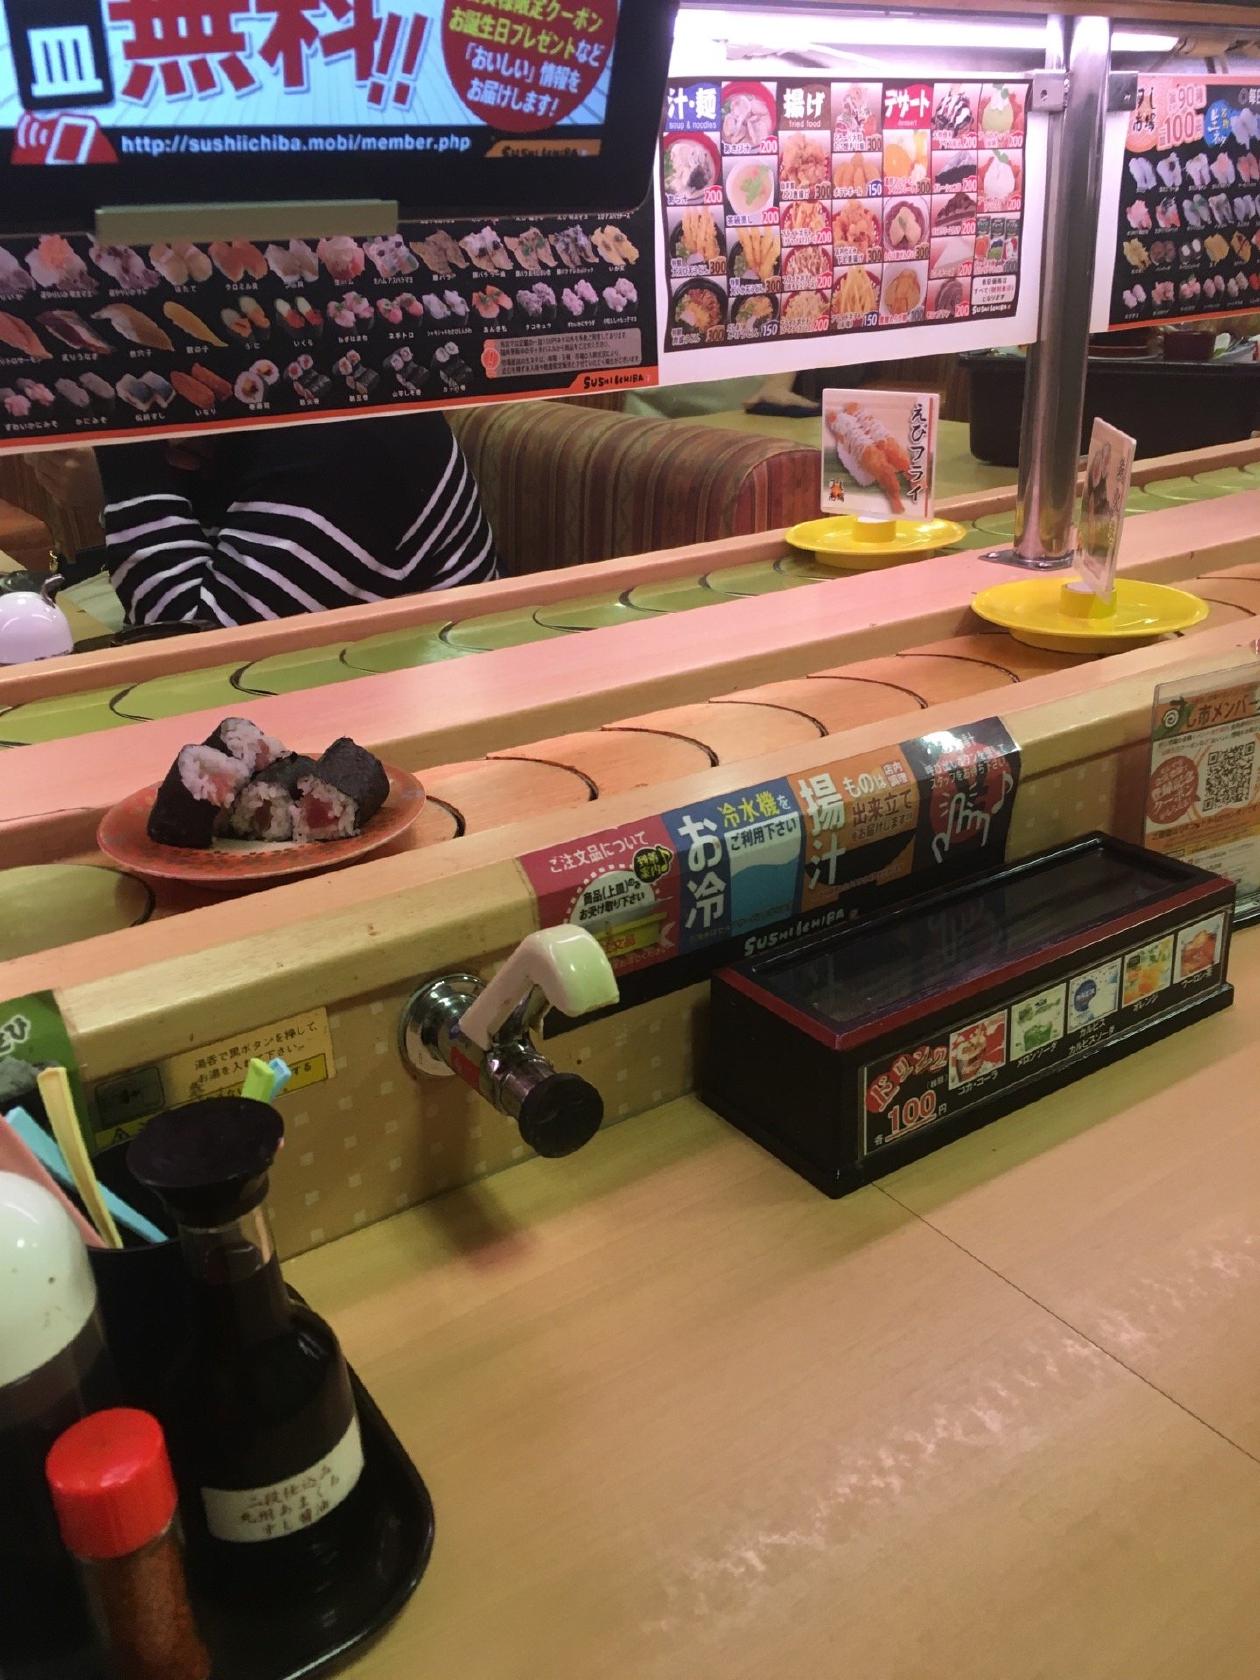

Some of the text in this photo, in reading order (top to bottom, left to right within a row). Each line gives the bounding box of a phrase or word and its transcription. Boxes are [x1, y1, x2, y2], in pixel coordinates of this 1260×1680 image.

[449, 7, 605, 67] お誕生日プレゼントなど
[783, 87, 825, 119] 揚げ
[885, 88, 930, 118] デザート
[121, 133, 472, 153] http://sushiichiba.mobi/member.php
[868, 184, 882, 196] 150
[863, 315, 878, 327] 150
[906, 403, 927, 502] えびフライ
[718, 790, 791, 828] 冷水機を
[852, 788, 913, 826] 出来立て
[730, 819, 797, 851] ご利用下さい
[549, 831, 649, 873] ご注文品について
[677, 815, 728, 929] お冷
[579, 891, 645, 921] お受け取り下さい
[744, 928, 794, 957] SUSHI
[957, 1070, 999, 1095] コカ・コーラ
